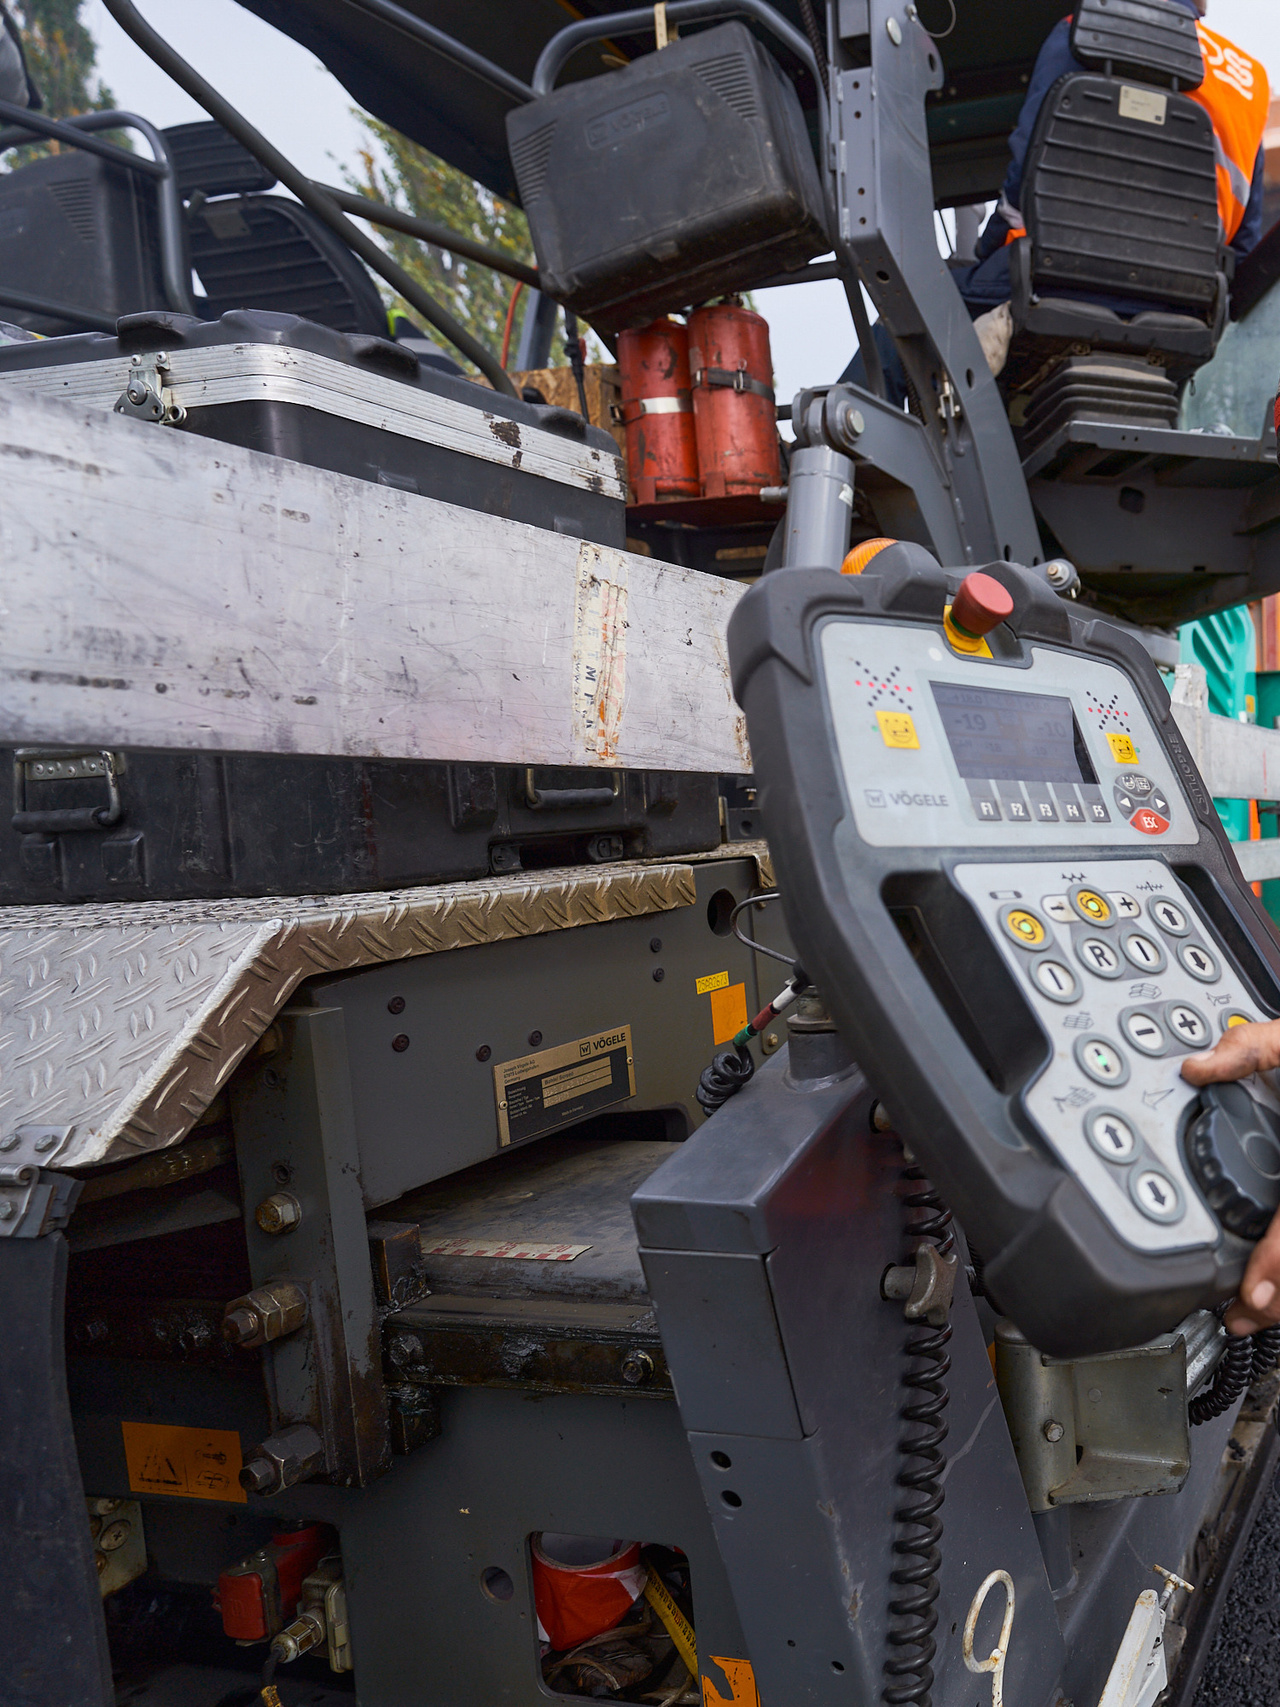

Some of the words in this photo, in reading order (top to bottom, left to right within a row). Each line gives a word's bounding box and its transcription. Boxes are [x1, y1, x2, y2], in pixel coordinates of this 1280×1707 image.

[1168, 733, 1206, 806] ERGOPLUS
[888, 789, 949, 807] VÖGELE
[980, 802, 994, 815] F1
[1010, 803, 1024, 816] F2
[1039, 803, 1053, 817] F3
[1066, 804, 1080, 817] F4
[1092, 805, 1105, 818] F5
[1143, 816, 1159, 829] ESC
[1088, 945, 1112, 967] R
[593, 1032, 626, 1050] VÖGELE
